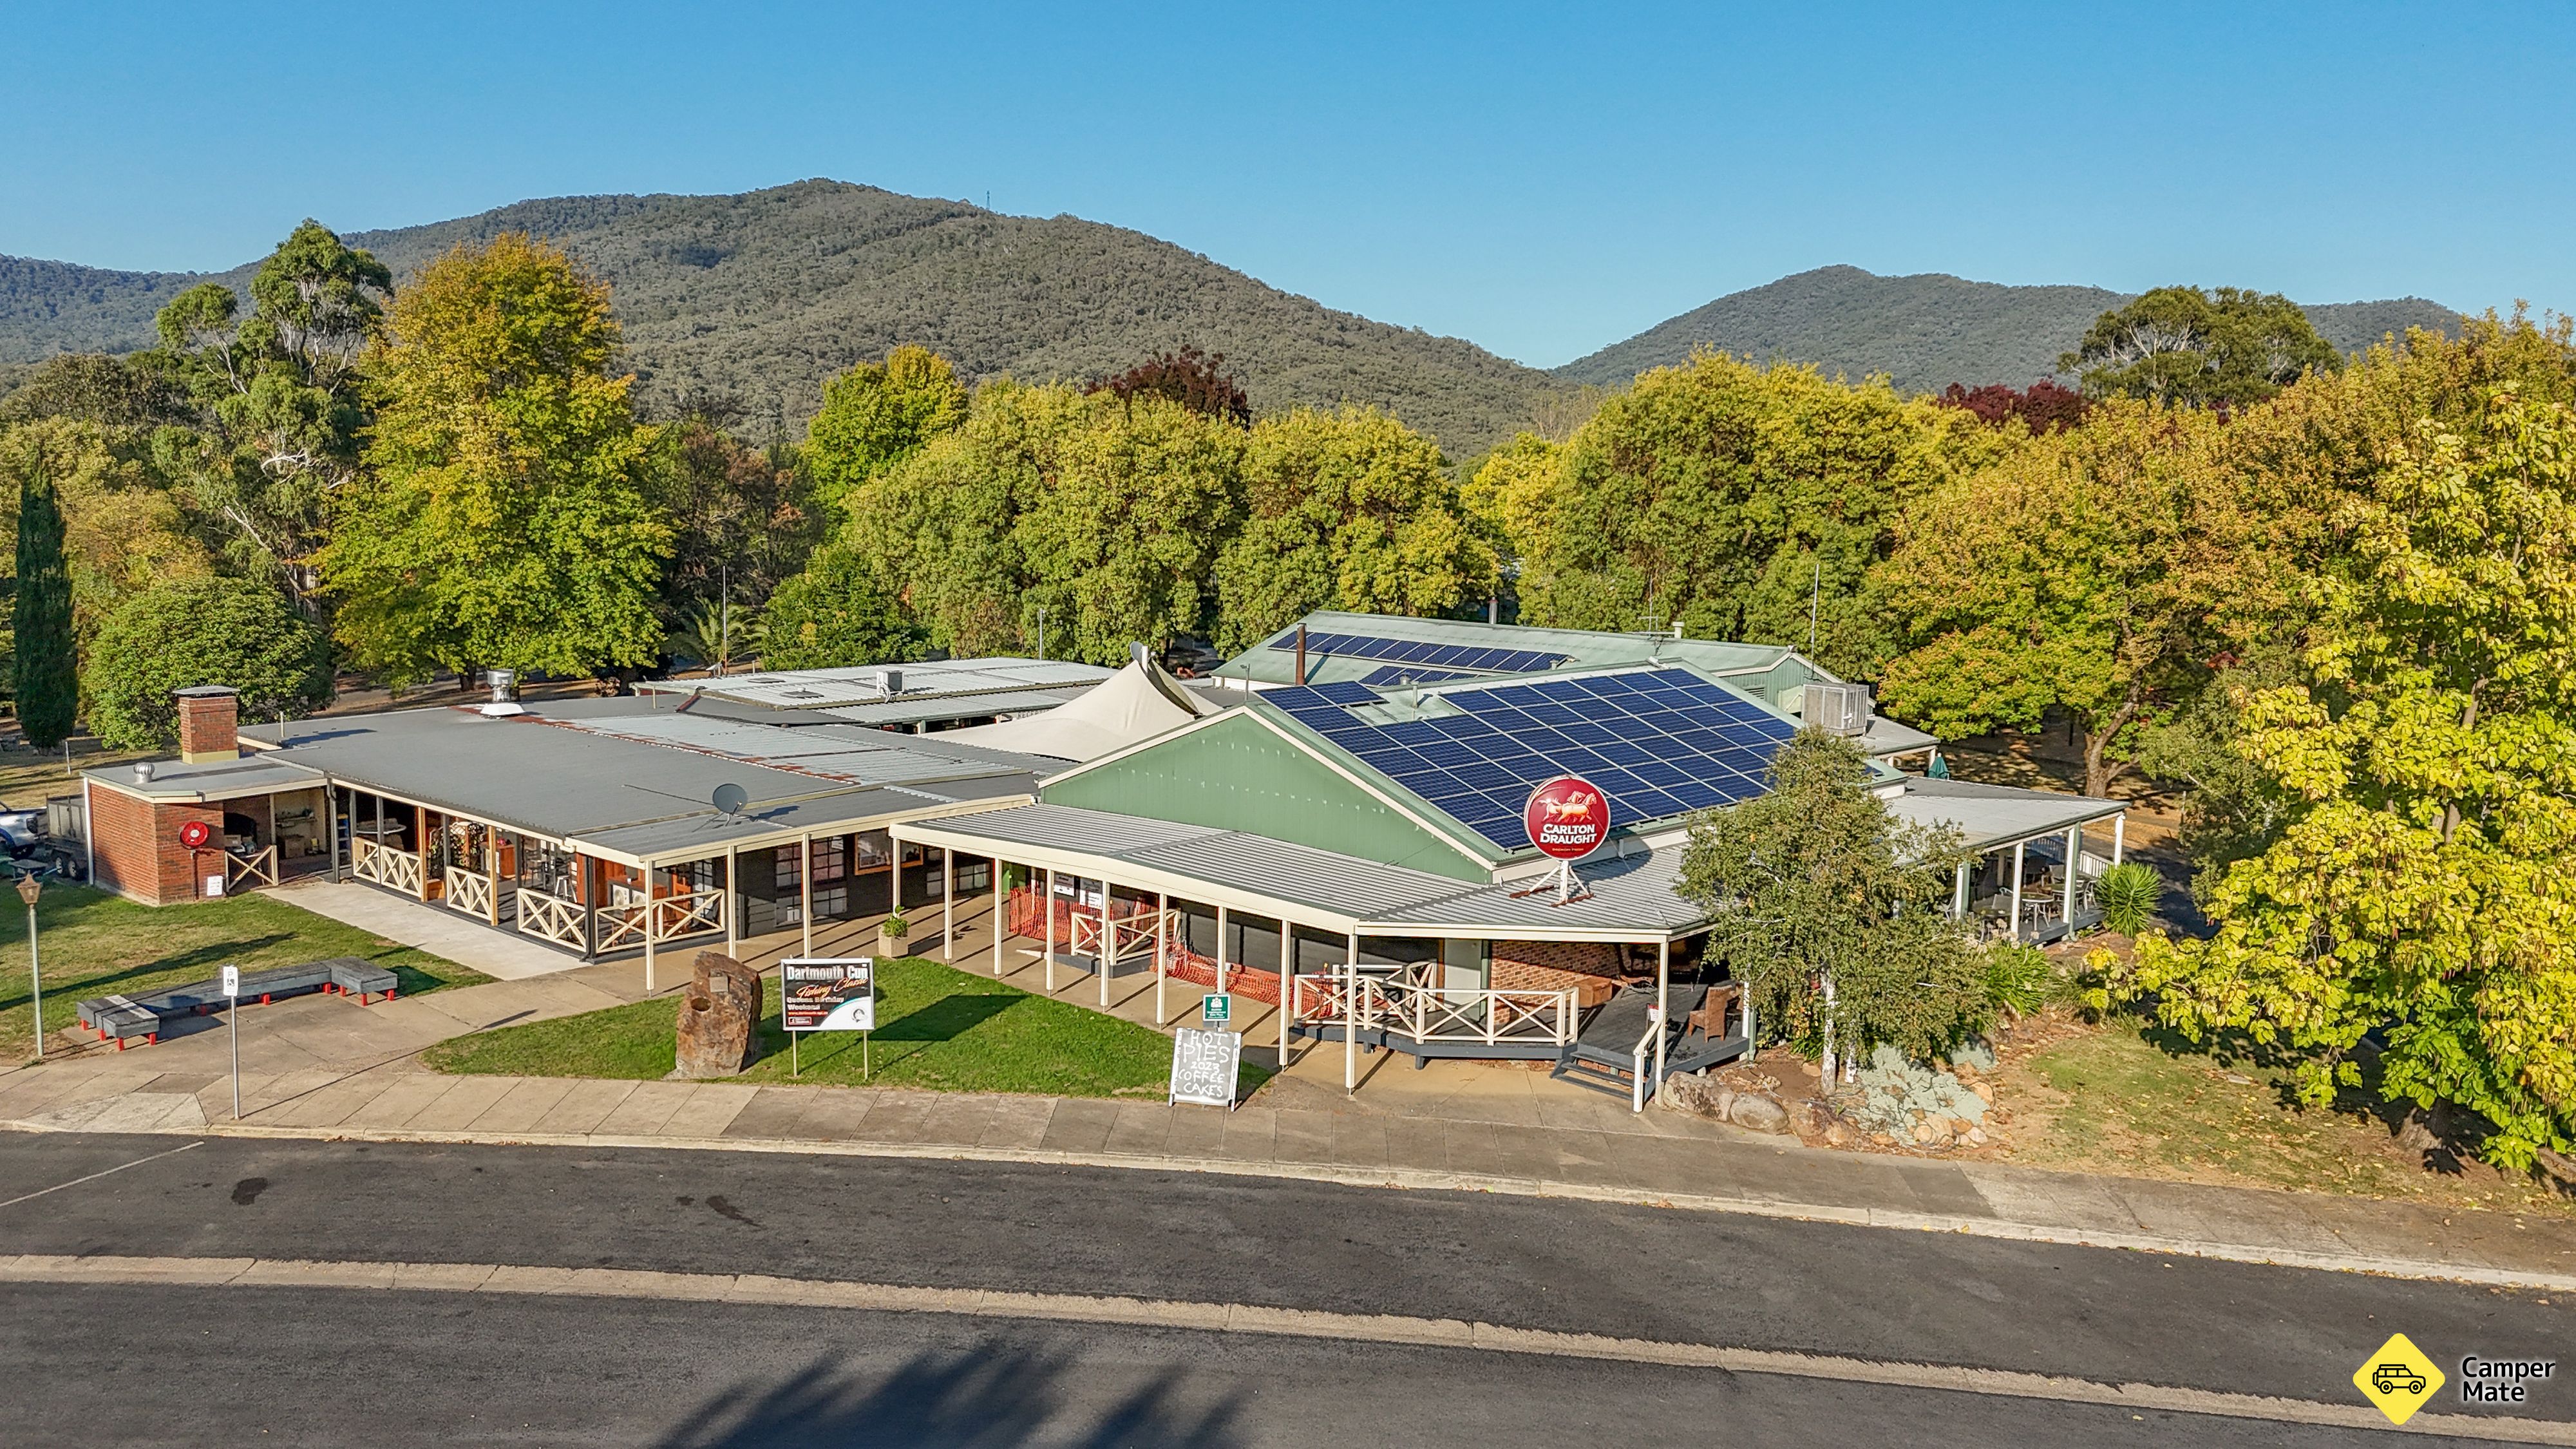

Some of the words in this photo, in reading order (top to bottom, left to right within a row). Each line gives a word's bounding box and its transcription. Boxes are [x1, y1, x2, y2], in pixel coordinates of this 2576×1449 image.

[1543, 824, 1595, 834] CARLTON
[1540, 832, 1597, 844] DRAUGHT
[787, 965, 844, 980] Dartmouth
[847, 965, 868, 980] Cup
[796, 985, 831, 998] Fishing
[833, 977, 868, 992] Classic
[1191, 1030, 1228, 1045] HOT
[1183, 1043, 1231, 1063] PIES
[1179, 1068, 1225, 1083] COFFEE
[1184, 1082, 1223, 1097] CAKES
